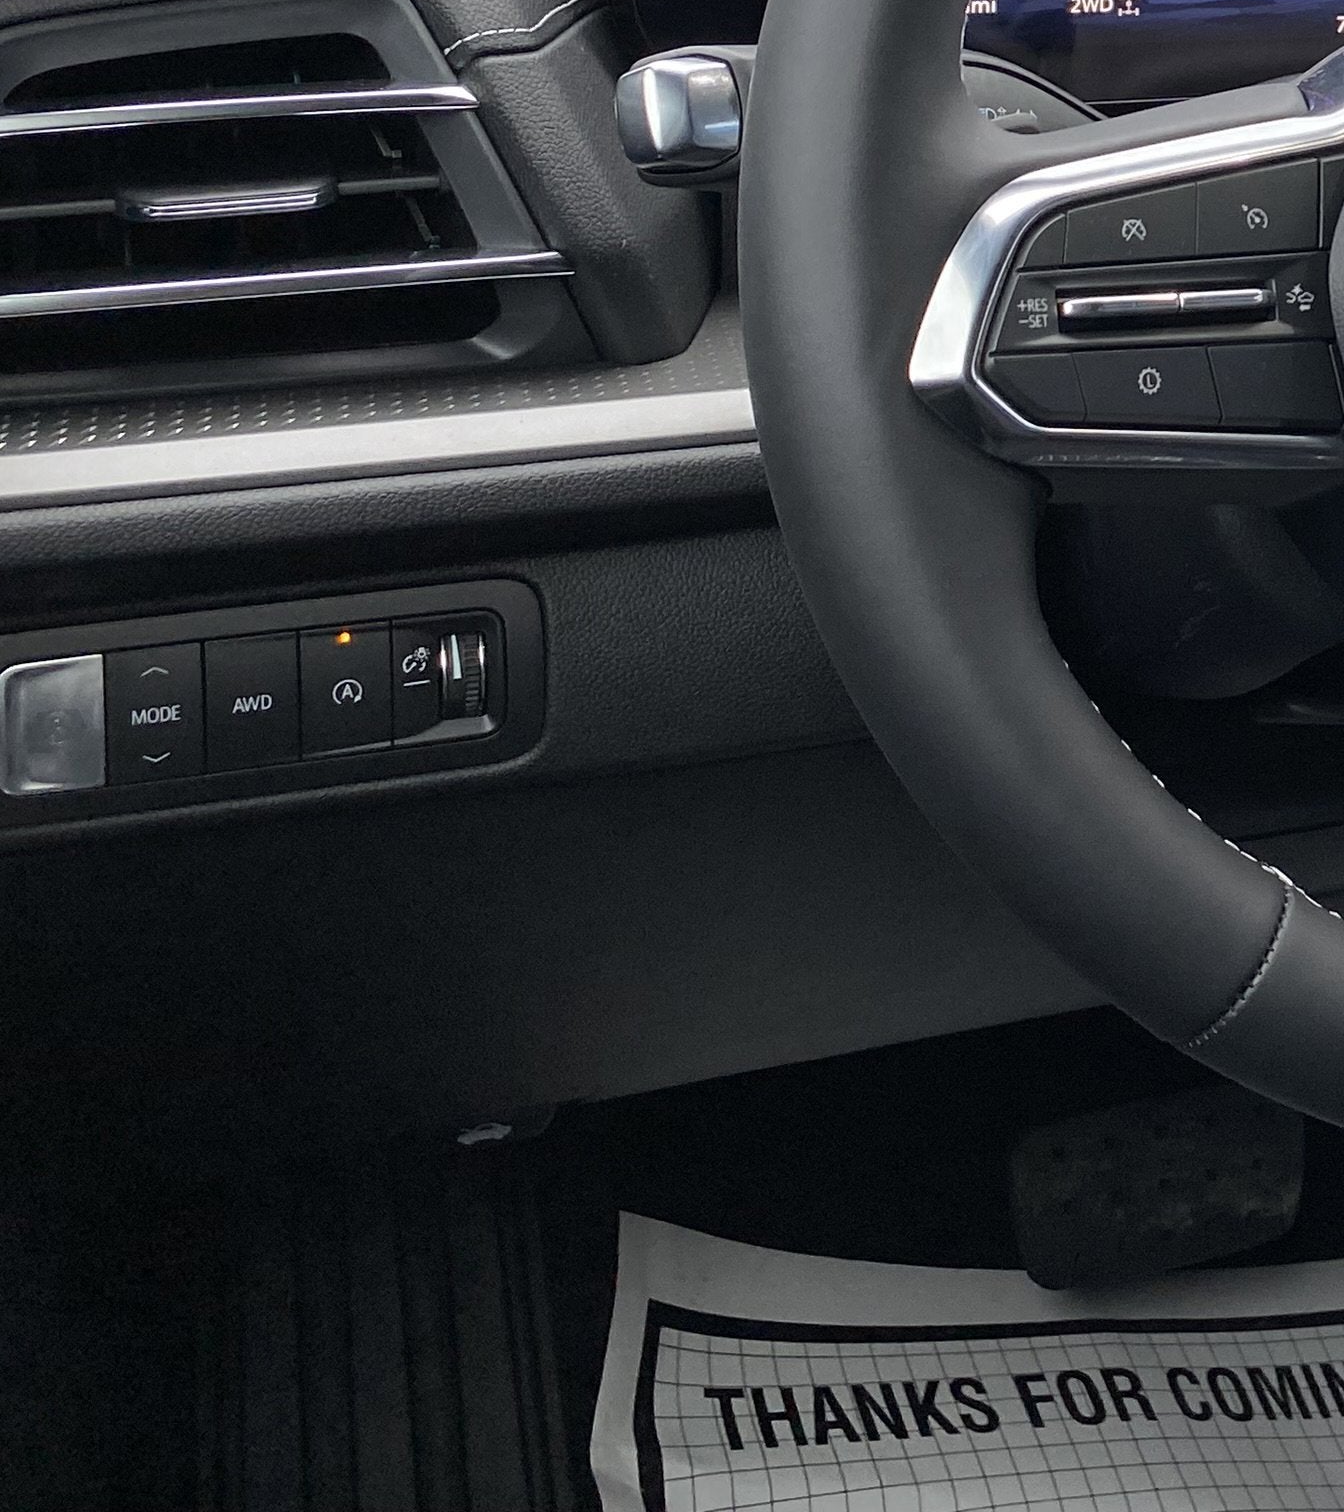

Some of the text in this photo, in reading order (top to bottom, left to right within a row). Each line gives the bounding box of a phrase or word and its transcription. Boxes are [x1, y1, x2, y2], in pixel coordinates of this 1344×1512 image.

[131, 704, 181, 727] MODE
[231, 694, 273, 715] AWD
[704, 1377, 1001, 1451] THANKS
[1018, 1366, 1157, 1430] FOR
